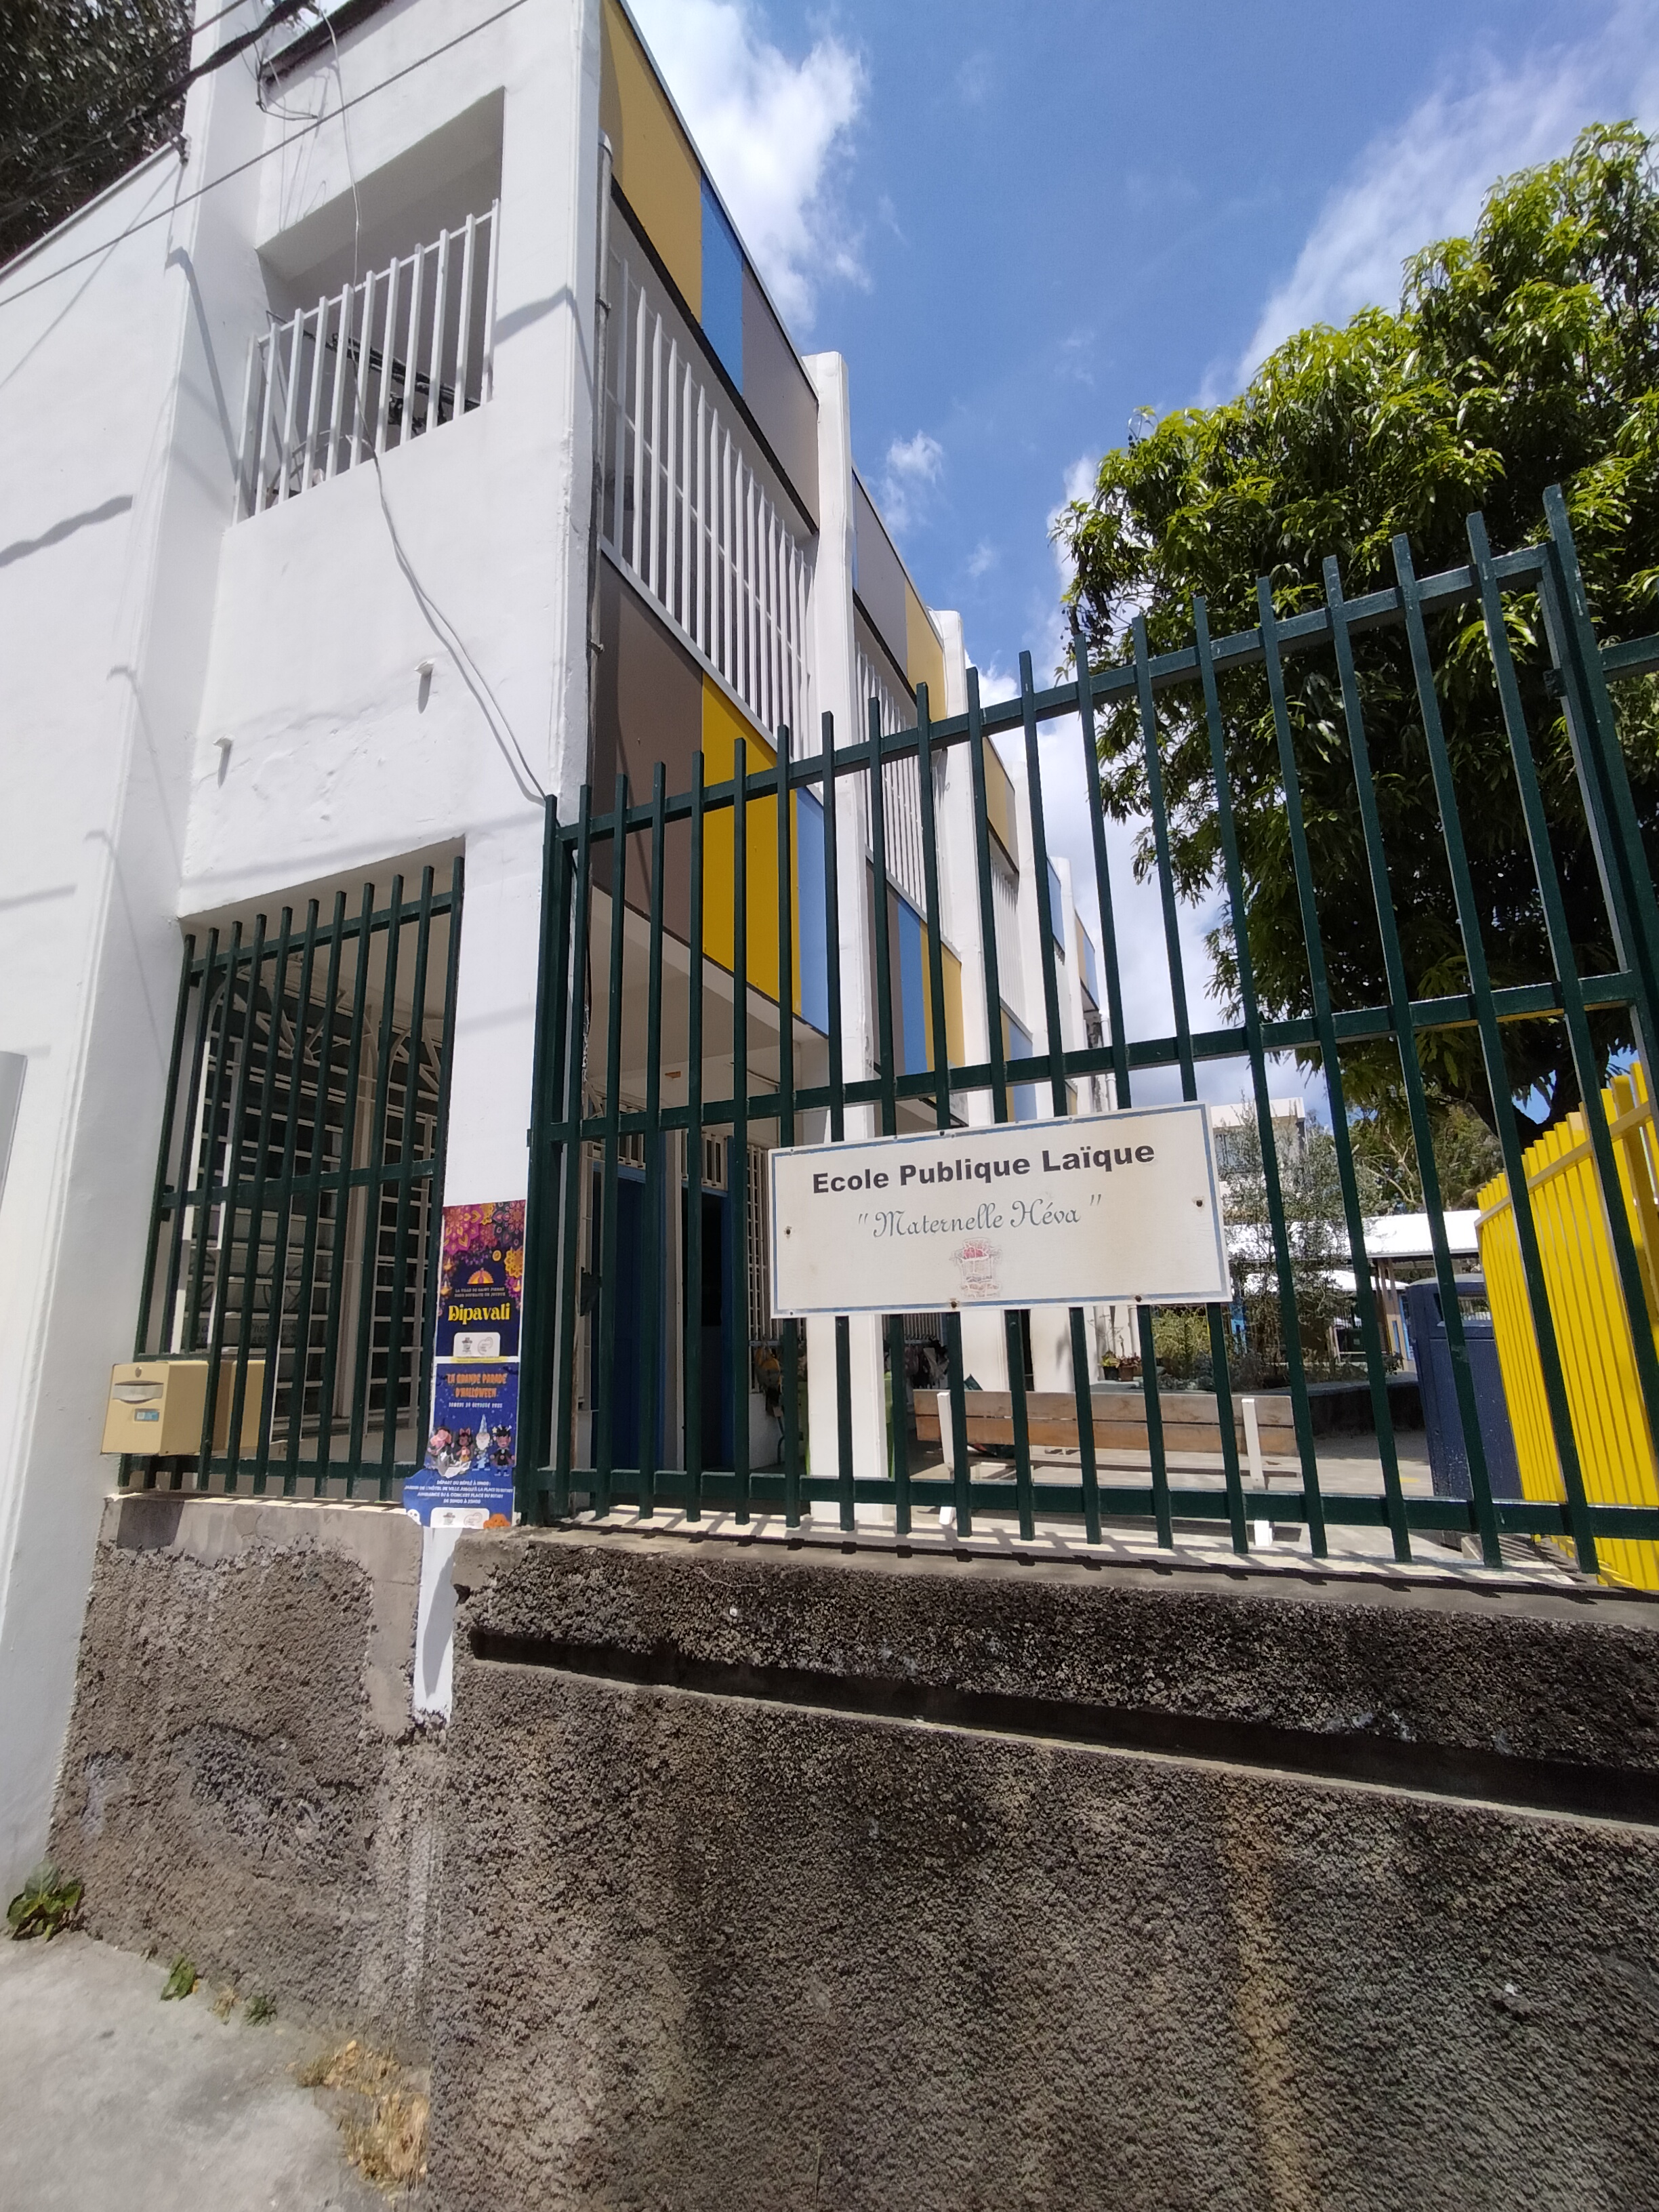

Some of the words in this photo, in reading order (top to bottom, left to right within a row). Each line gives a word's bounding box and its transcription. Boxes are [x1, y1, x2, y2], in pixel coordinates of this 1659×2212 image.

[813, 1168, 889, 1193] Ecole
[899, 1157, 1031, 1186] Publique
[1042, 1144, 1155, 1172] Laïque
[873, 1202, 1004, 1238] Maternelle
[1010, 1197, 1081, 1229] Héva
[447, 1303, 510, 1325] Dipavali
[446, 1374, 455, 1384] LA
[456, 1373, 481, 1384] GRANDE
[482, 1373, 508, 1384] PARADE
